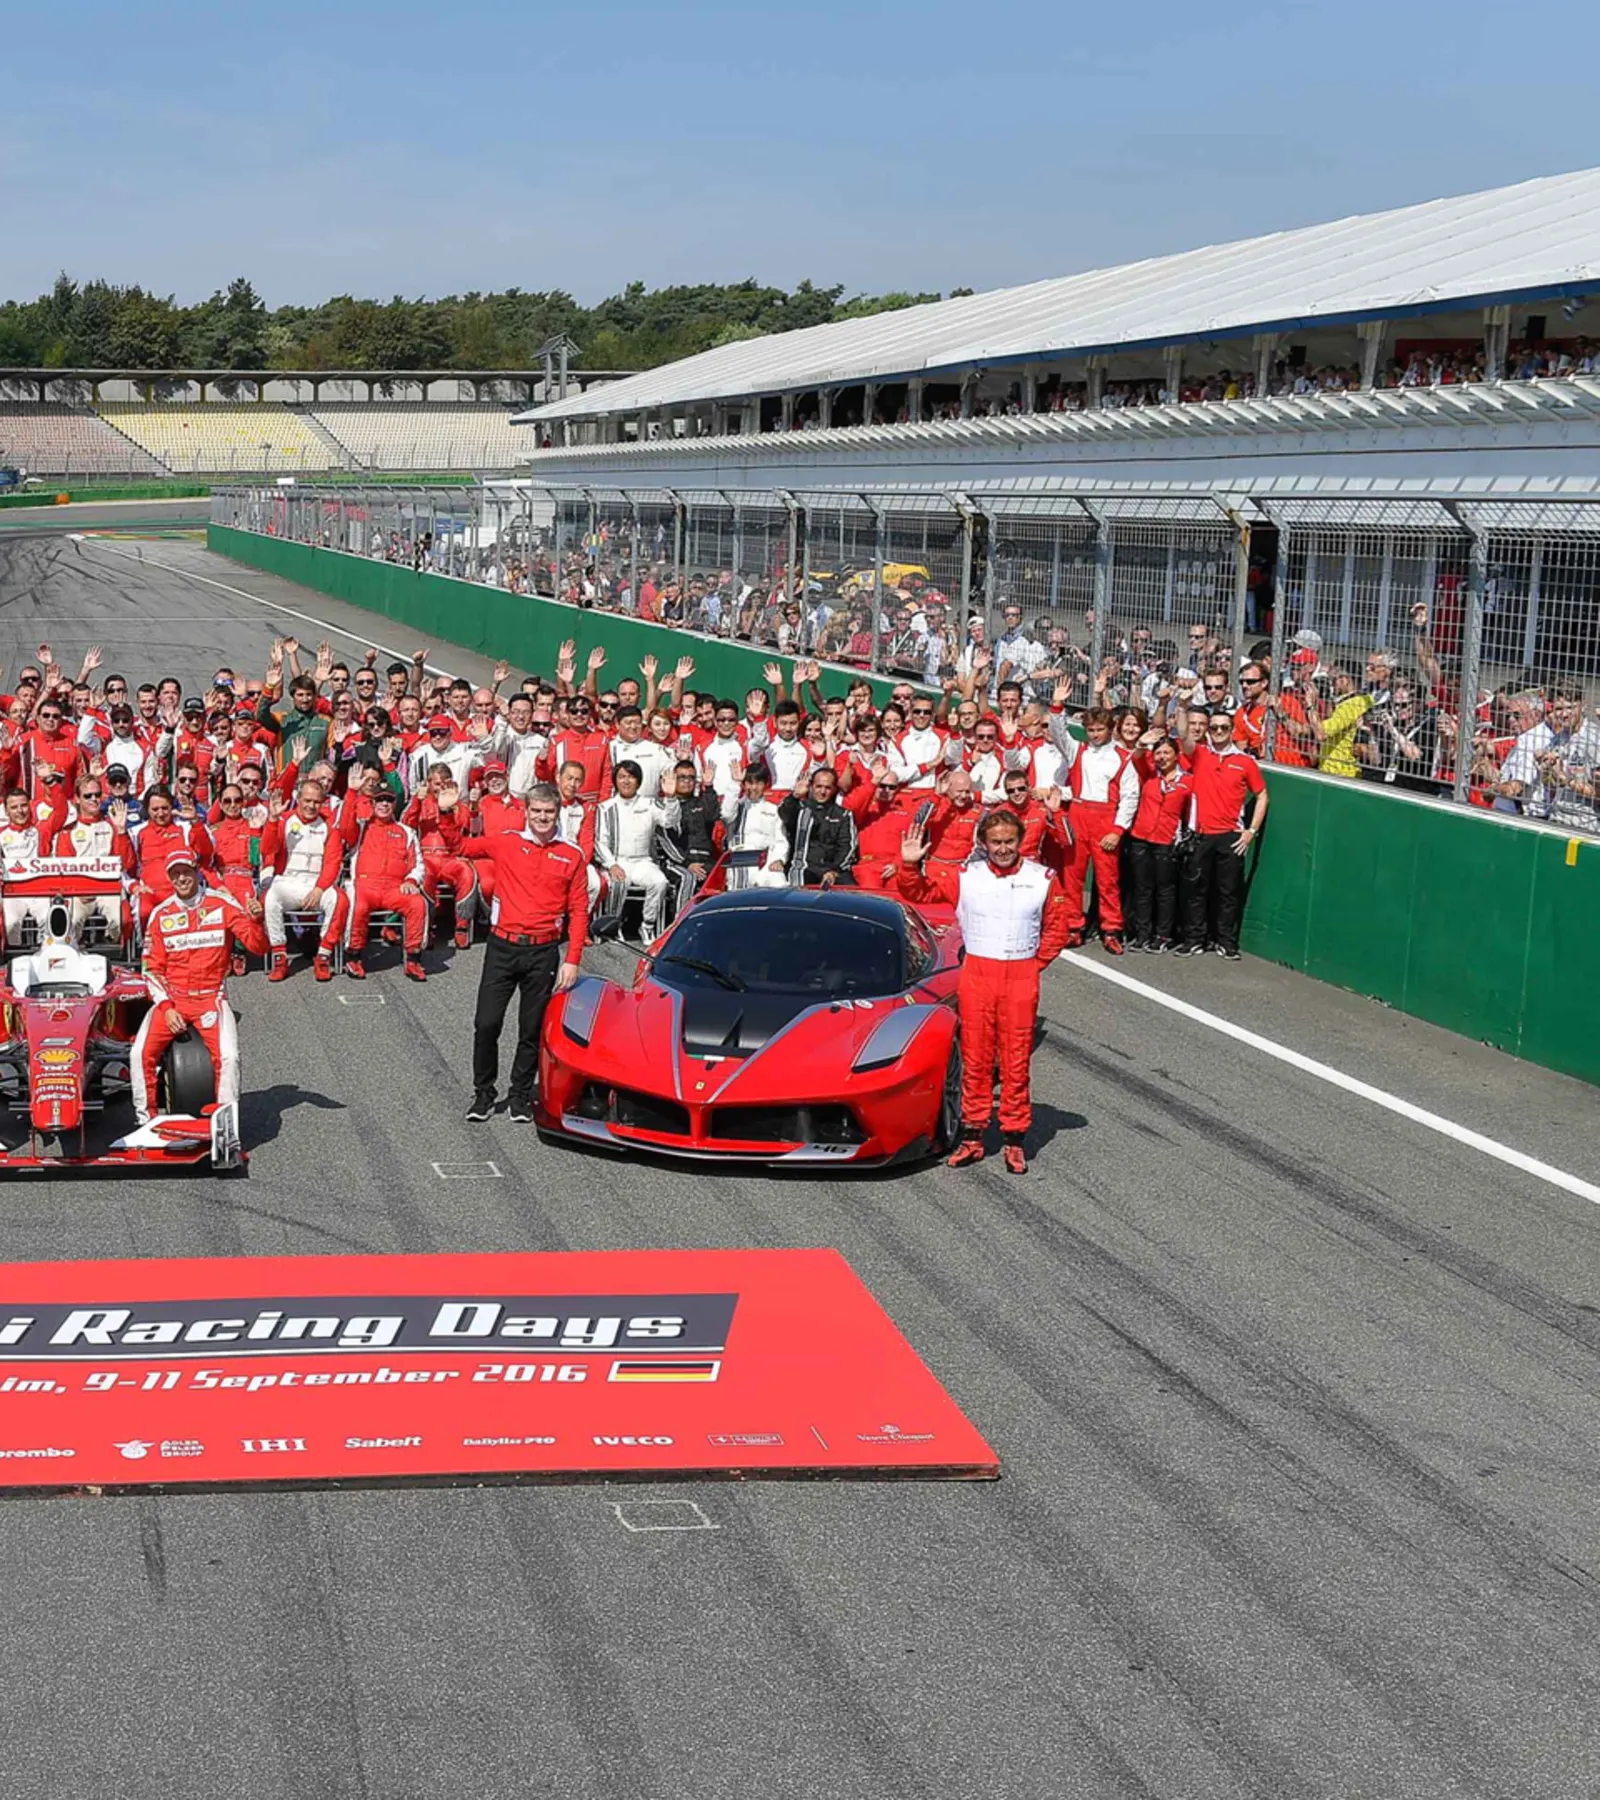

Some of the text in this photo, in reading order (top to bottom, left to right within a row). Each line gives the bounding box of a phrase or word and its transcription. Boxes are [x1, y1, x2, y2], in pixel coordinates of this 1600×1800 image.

[29, 858, 119, 874] Santander
[48, 1309, 406, 1348] Racing
[427, 1302, 687, 1348] Days
[82, 1371, 182, 1391] 9-11
[188, 1367, 460, 1392] September
[472, 1364, 589, 1383] 2016
[241, 1438, 308, 1452] IHI
[344, 1436, 422, 1449] Sabelt
[592, 1435, 674, 1446] IVECO
